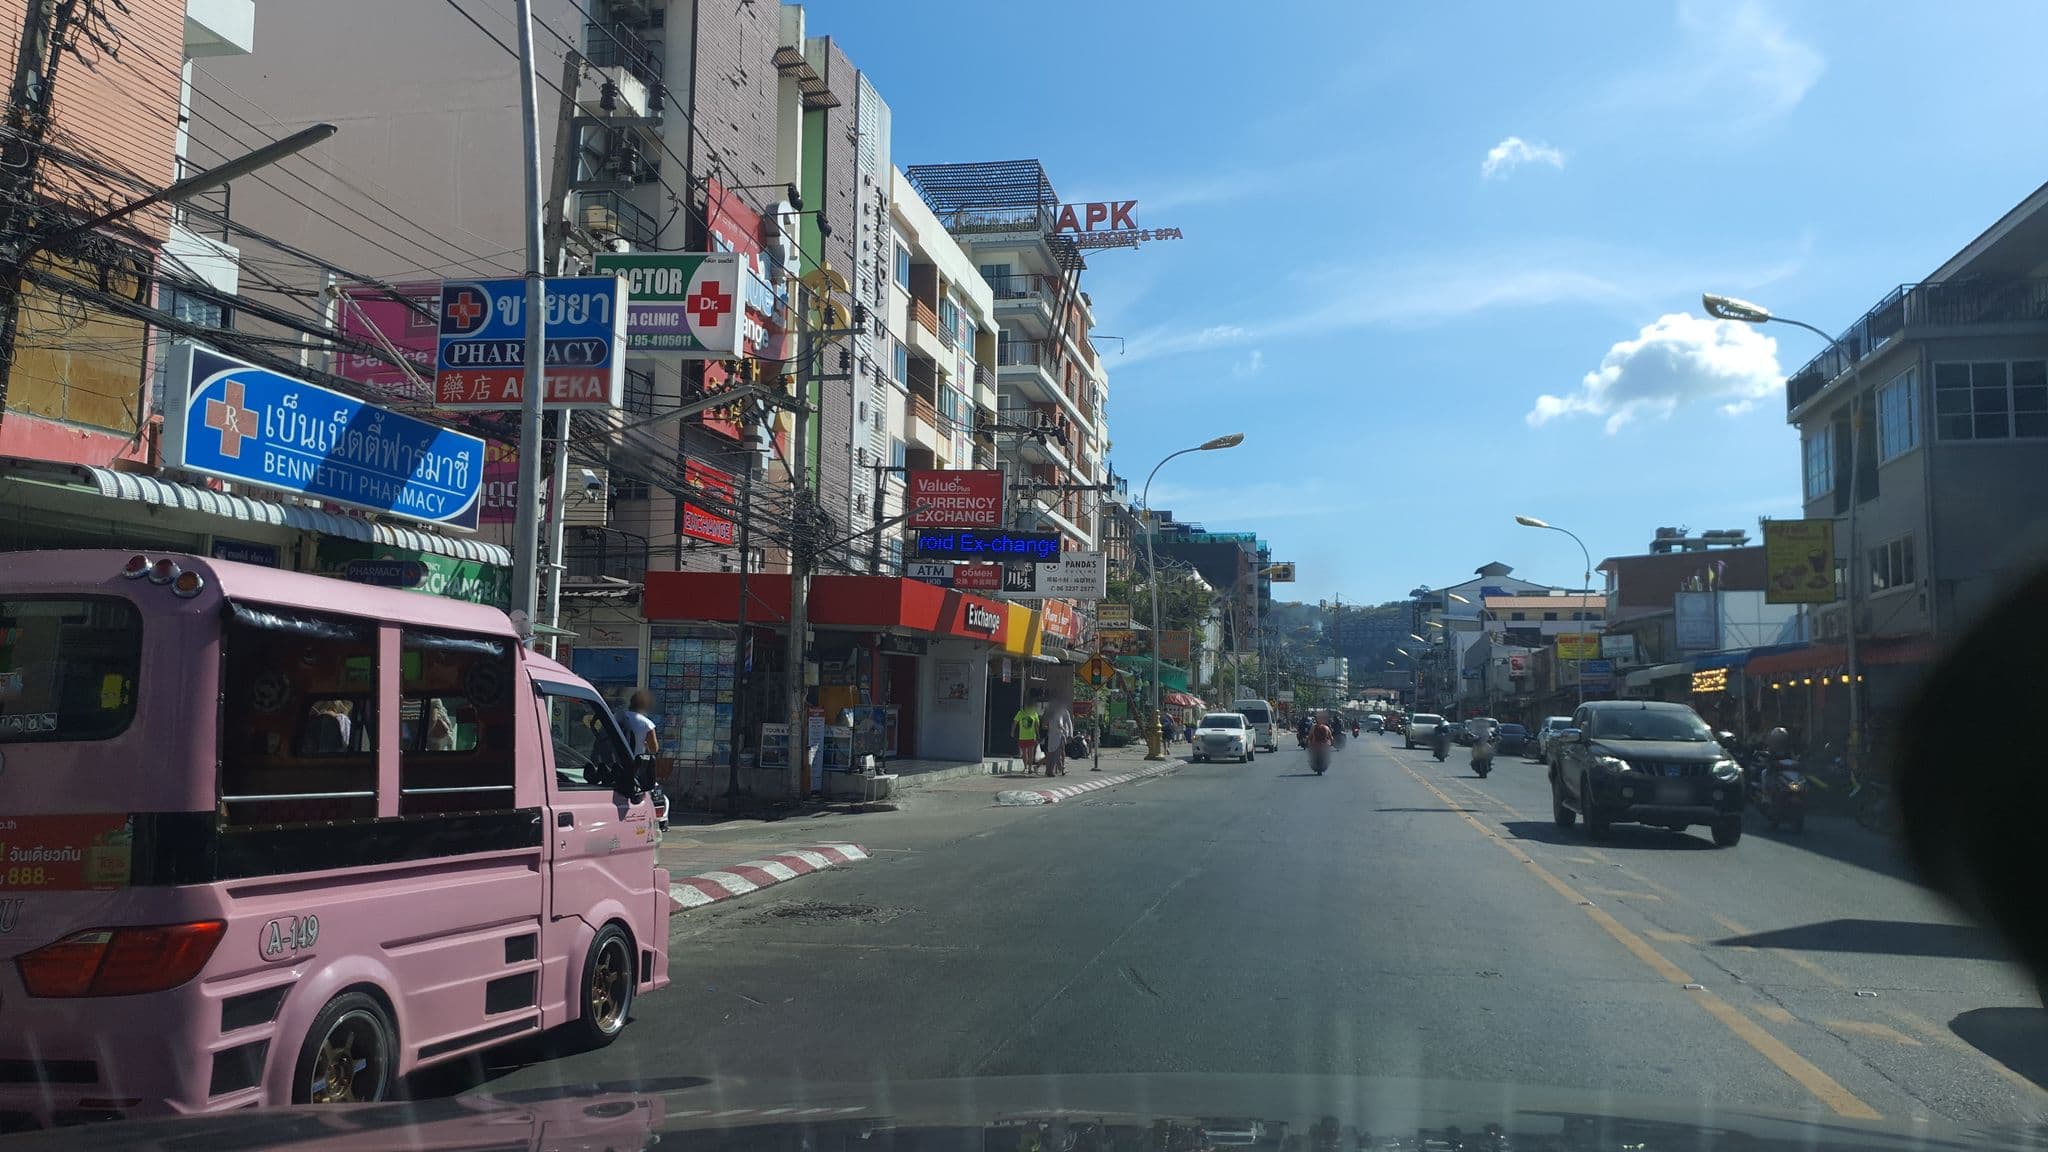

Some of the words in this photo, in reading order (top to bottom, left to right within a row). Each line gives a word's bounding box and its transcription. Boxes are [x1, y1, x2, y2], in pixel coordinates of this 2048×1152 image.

[1055, 200, 1138, 234] APK
[1155, 227, 1184, 241] SPA
[601, 267, 683, 295] CTOR
[497, 292, 610, 327] ขยยา
[700, 297, 719, 310] Dr.
[640, 312, 679, 327] CLINIC
[351, 346, 428, 368] Serice
[452, 341, 599, 364] PHARACY
[442, 372, 492, 402] 藥店
[265, 392, 471, 490] เบ็นเน็ตตี้ฟาร์มาซี
[264, 451, 353, 490] BENNETTI
[359, 475, 446, 514] PHARMACY
[915, 496, 996, 509] CURRENCY
[684, 511, 731, 541] EXCHANGE
[915, 510, 996, 523] EXCHANGE
[350, 566, 402, 577] PHARMACY
[917, 565, 945, 576] ATM
[961, 568, 993, 577] обмен
[1065, 560, 1097, 568] PANDA'S
[968, 603, 1001, 635] Exchange
[265, 914, 320, 957] A-149
